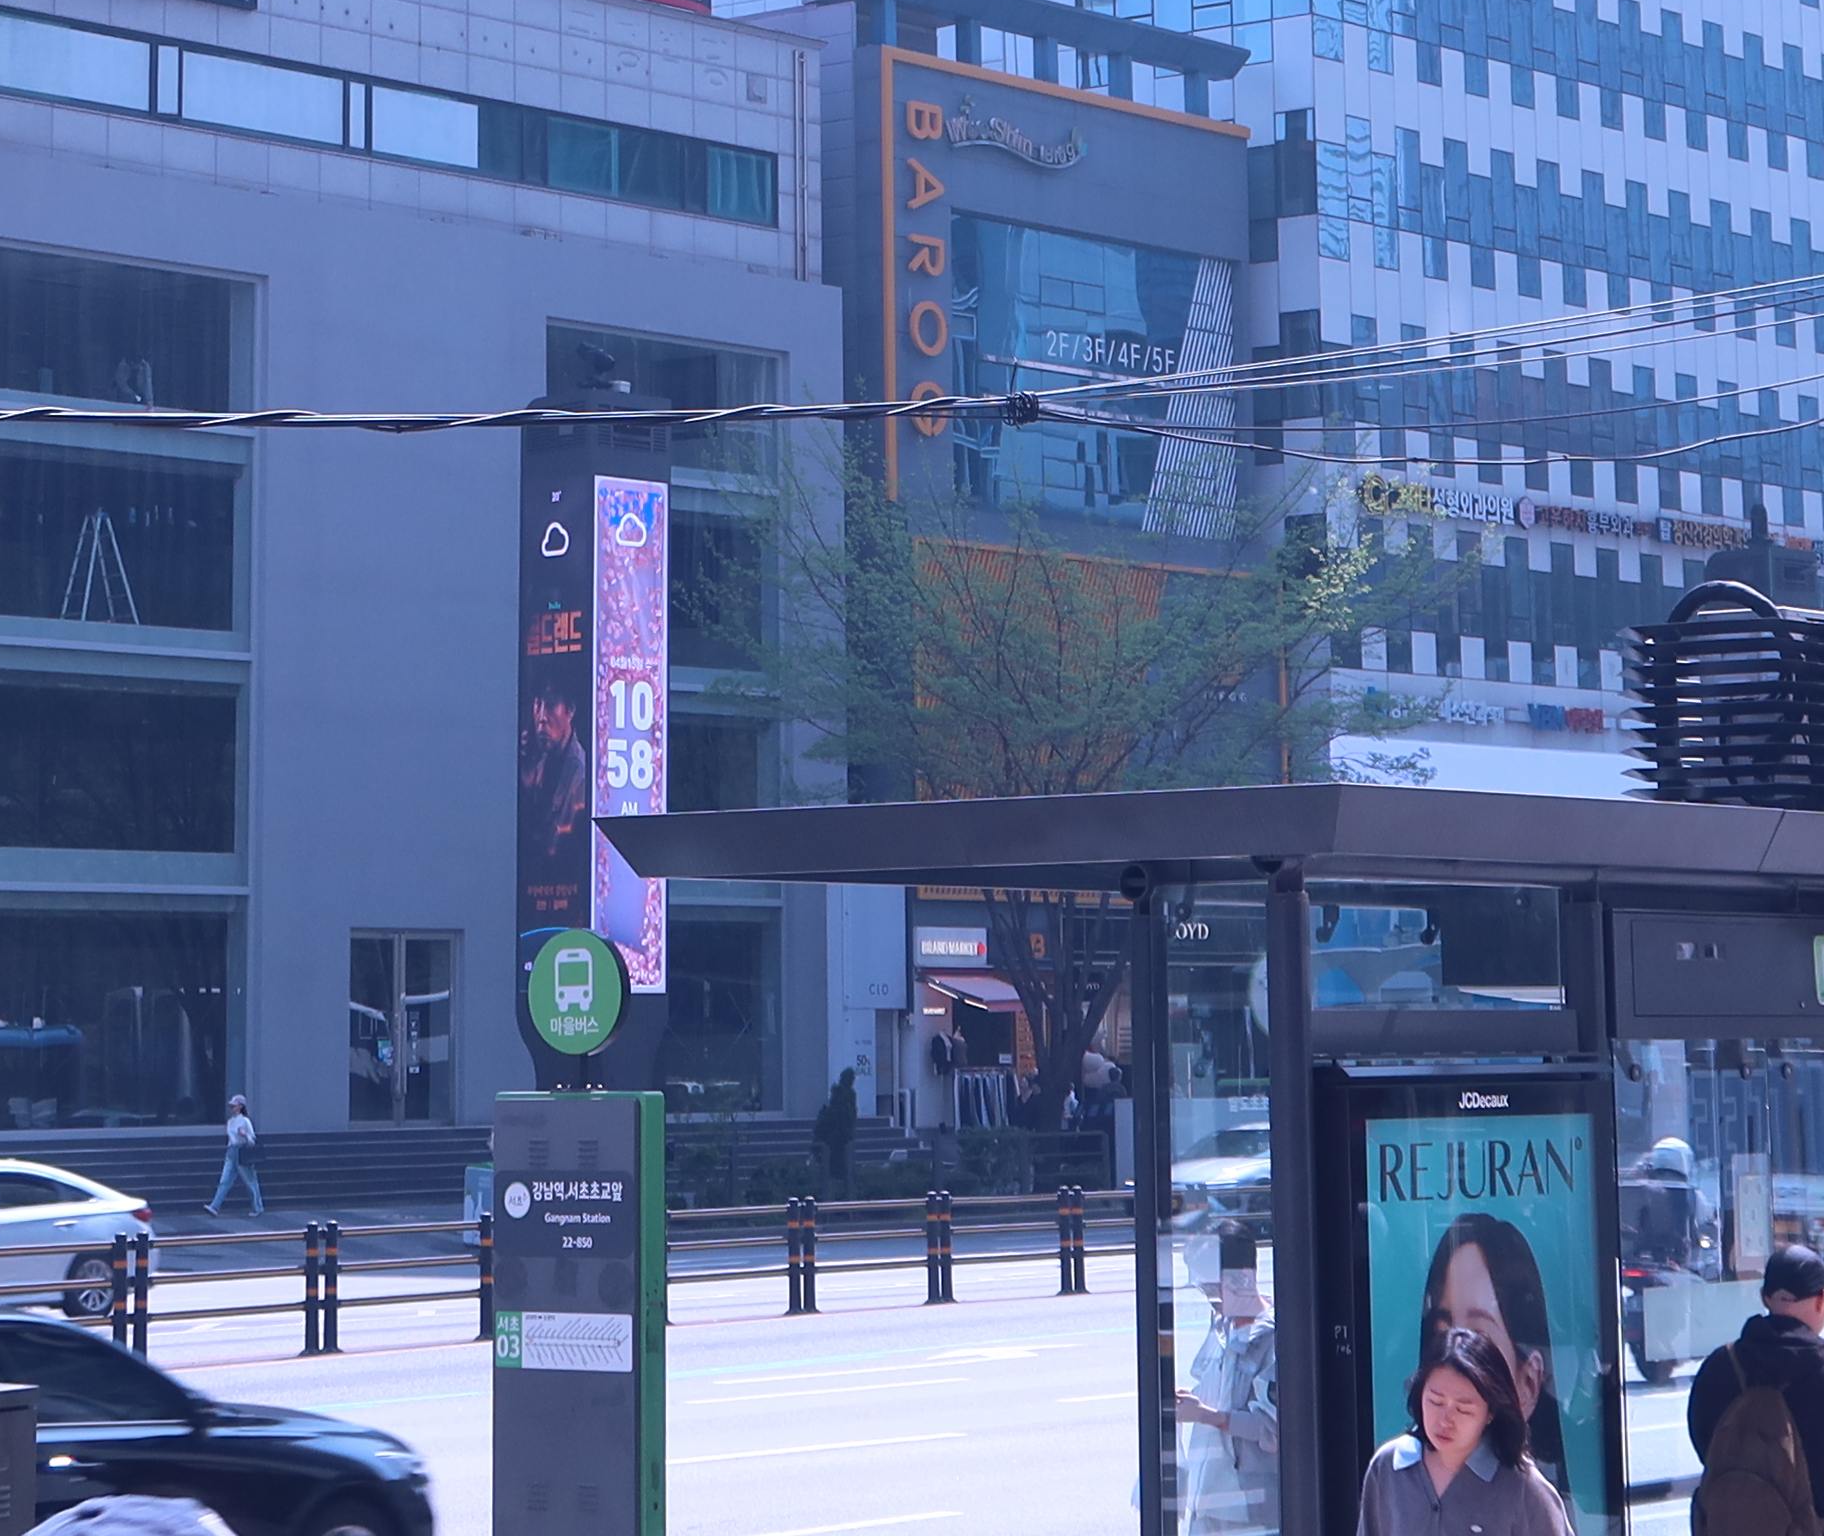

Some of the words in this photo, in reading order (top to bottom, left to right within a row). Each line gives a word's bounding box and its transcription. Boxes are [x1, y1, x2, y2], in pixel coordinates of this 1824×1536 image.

[1045, 329, 1177, 375] 2F/3F/4F/5F
[609, 679, 654, 731] 10
[606, 738, 654, 790] 58
[620, 800, 639, 816] AM
[549, 1016, 600, 1036] 마을버스
[1458, 1091, 1509, 1110] JCDecaux
[544, 1212, 581, 1226] Gangnam
[582, 1211, 611, 1224] Station
[561, 1236, 594, 1249] 22-850
[497, 1315, 521, 1332] 서초
[497, 1334, 521, 1359] 03
